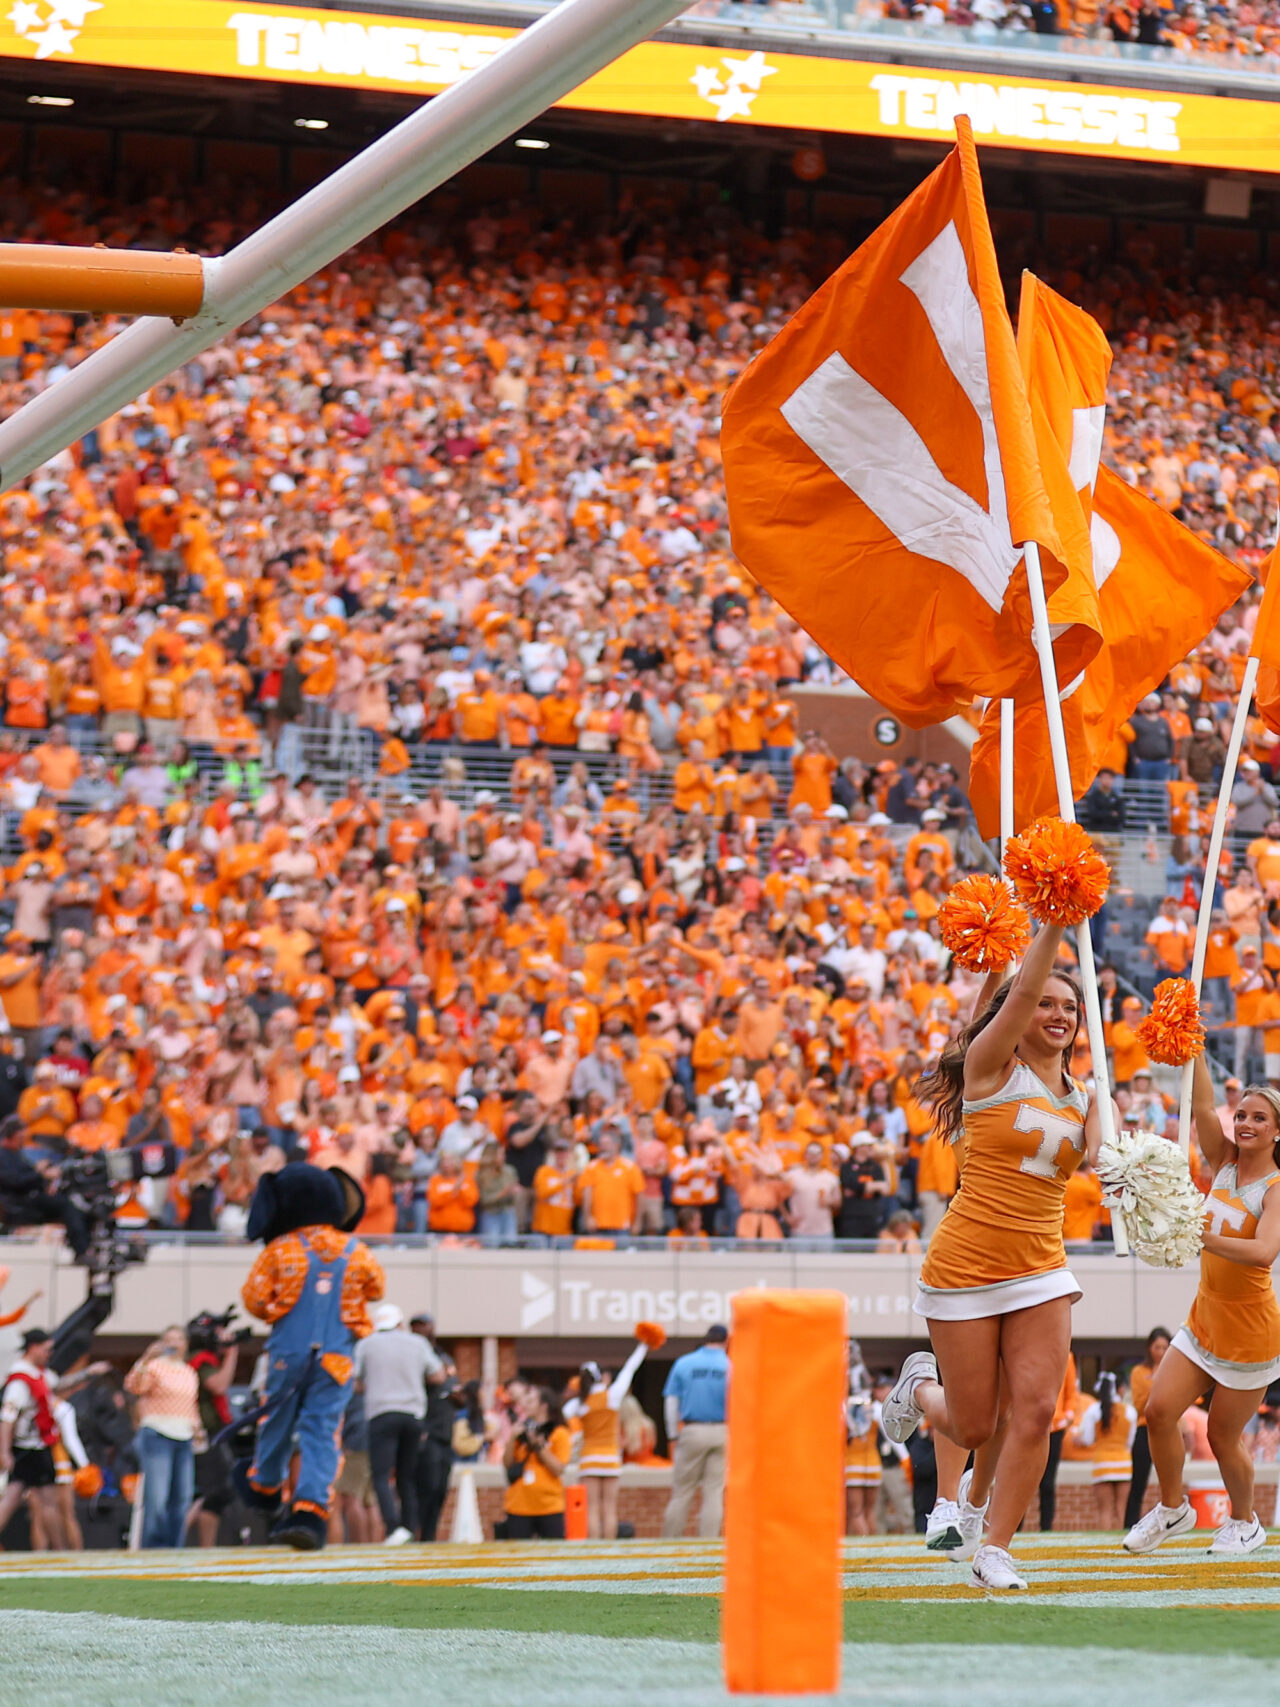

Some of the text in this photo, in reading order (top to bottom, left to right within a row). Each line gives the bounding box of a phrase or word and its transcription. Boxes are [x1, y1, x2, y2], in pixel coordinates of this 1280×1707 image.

[228, 13, 515, 83] TENNESS
[869, 74, 1182, 150] TENNESSEE
[877, 719, 897, 744] S
[1013, 1103, 1087, 1179] T
